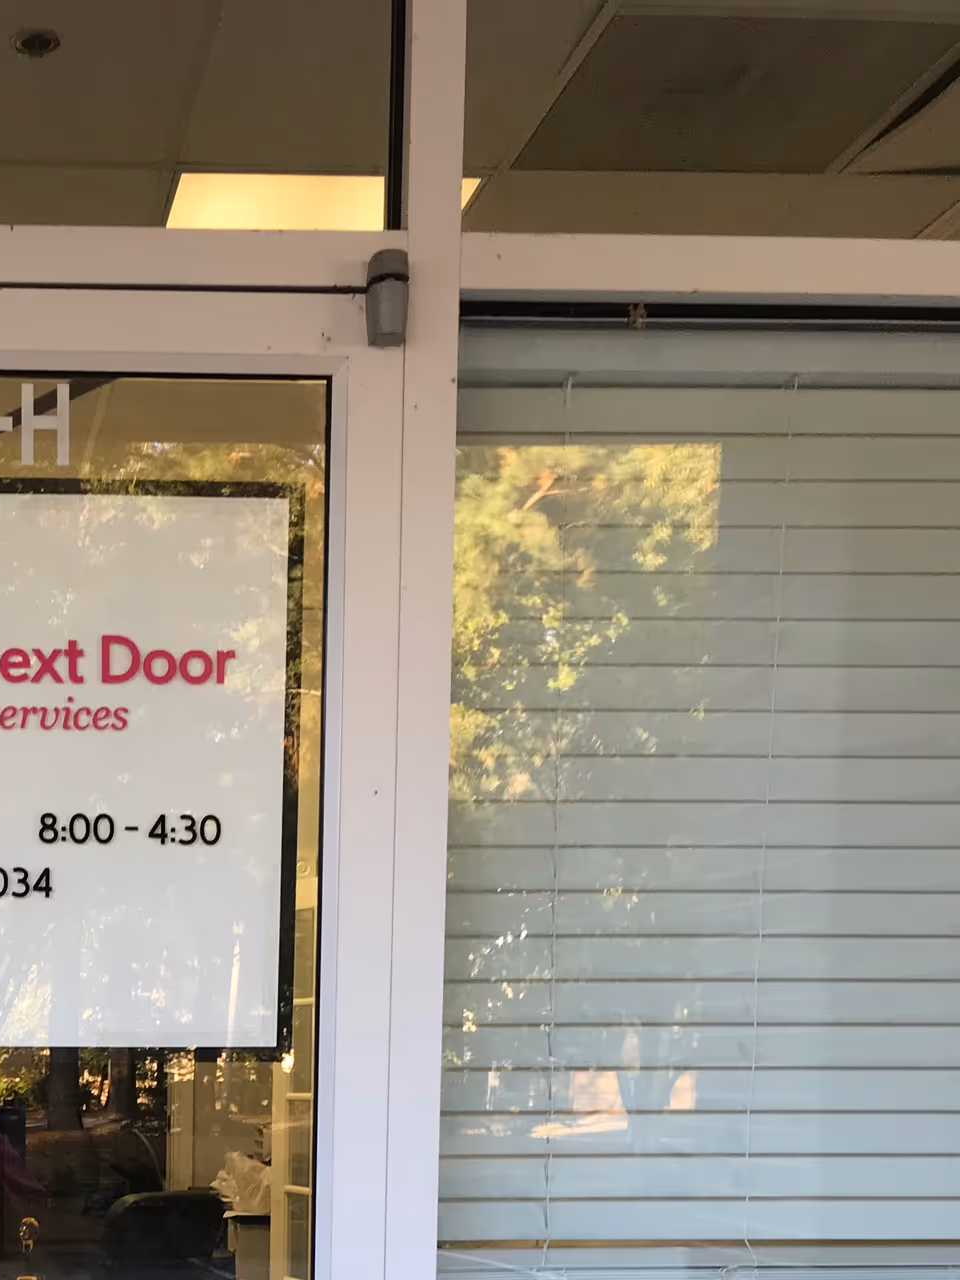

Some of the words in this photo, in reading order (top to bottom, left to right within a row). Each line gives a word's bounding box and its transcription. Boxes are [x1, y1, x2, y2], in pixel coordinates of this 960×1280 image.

[100, 636, 236, 686] Door
[38, 814, 115, 845] 8:00
[148, 814, 222, 846] 4:30
